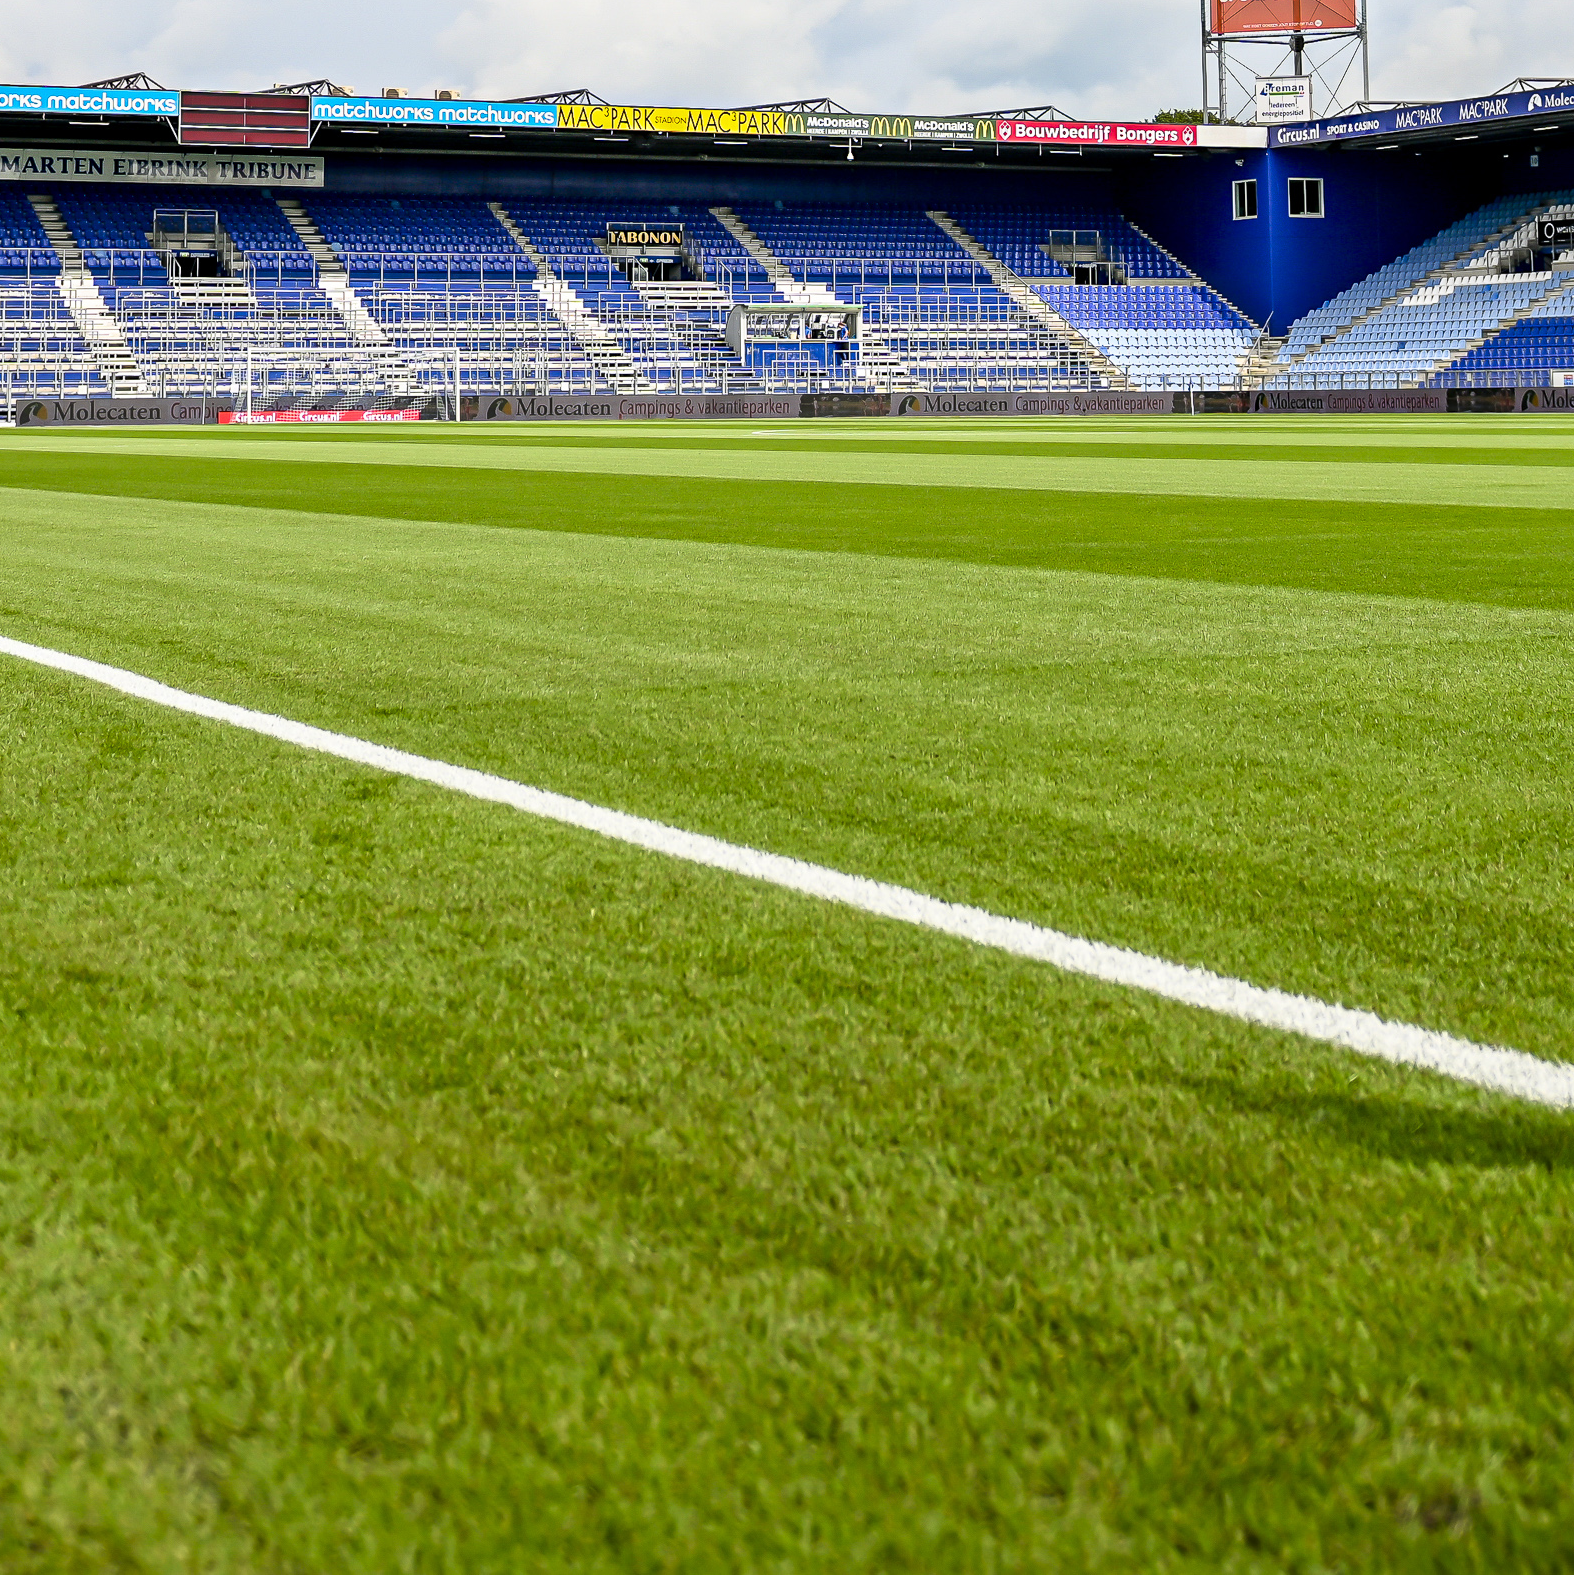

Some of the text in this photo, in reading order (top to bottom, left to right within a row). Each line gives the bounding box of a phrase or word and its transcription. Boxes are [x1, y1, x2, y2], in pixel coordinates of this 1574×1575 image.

[1260, 82, 1305, 96] Breman
[48, 92, 176, 112] matchworks
[314, 101, 555, 124] matchworks matchworks
[654, 115, 687, 124] STADION
[807, 116, 869, 128] McDonald's
[914, 120, 974, 132] McDonald's
[1015, 123, 1178, 143] Bouwbedrijf Bongers
[1277, 119, 1380, 144] Circus.nl SPORT & CASINO
[0, 154, 317, 181] MARTEN EIBRINK TRIBUNE
[609, 231, 682, 244] TABONON
[52, 401, 162, 422] Molecaten
[516, 398, 790, 419] Molecaten Campings & vakantieparken
[924, 394, 1165, 415] Molecaten Campings & vakantieparken
[1268, 392, 1440, 412] Molecaten Campings & vakantieparken
[299, 412, 340, 422] Circus.nl
[363, 411, 403, 421] Circus.nl
